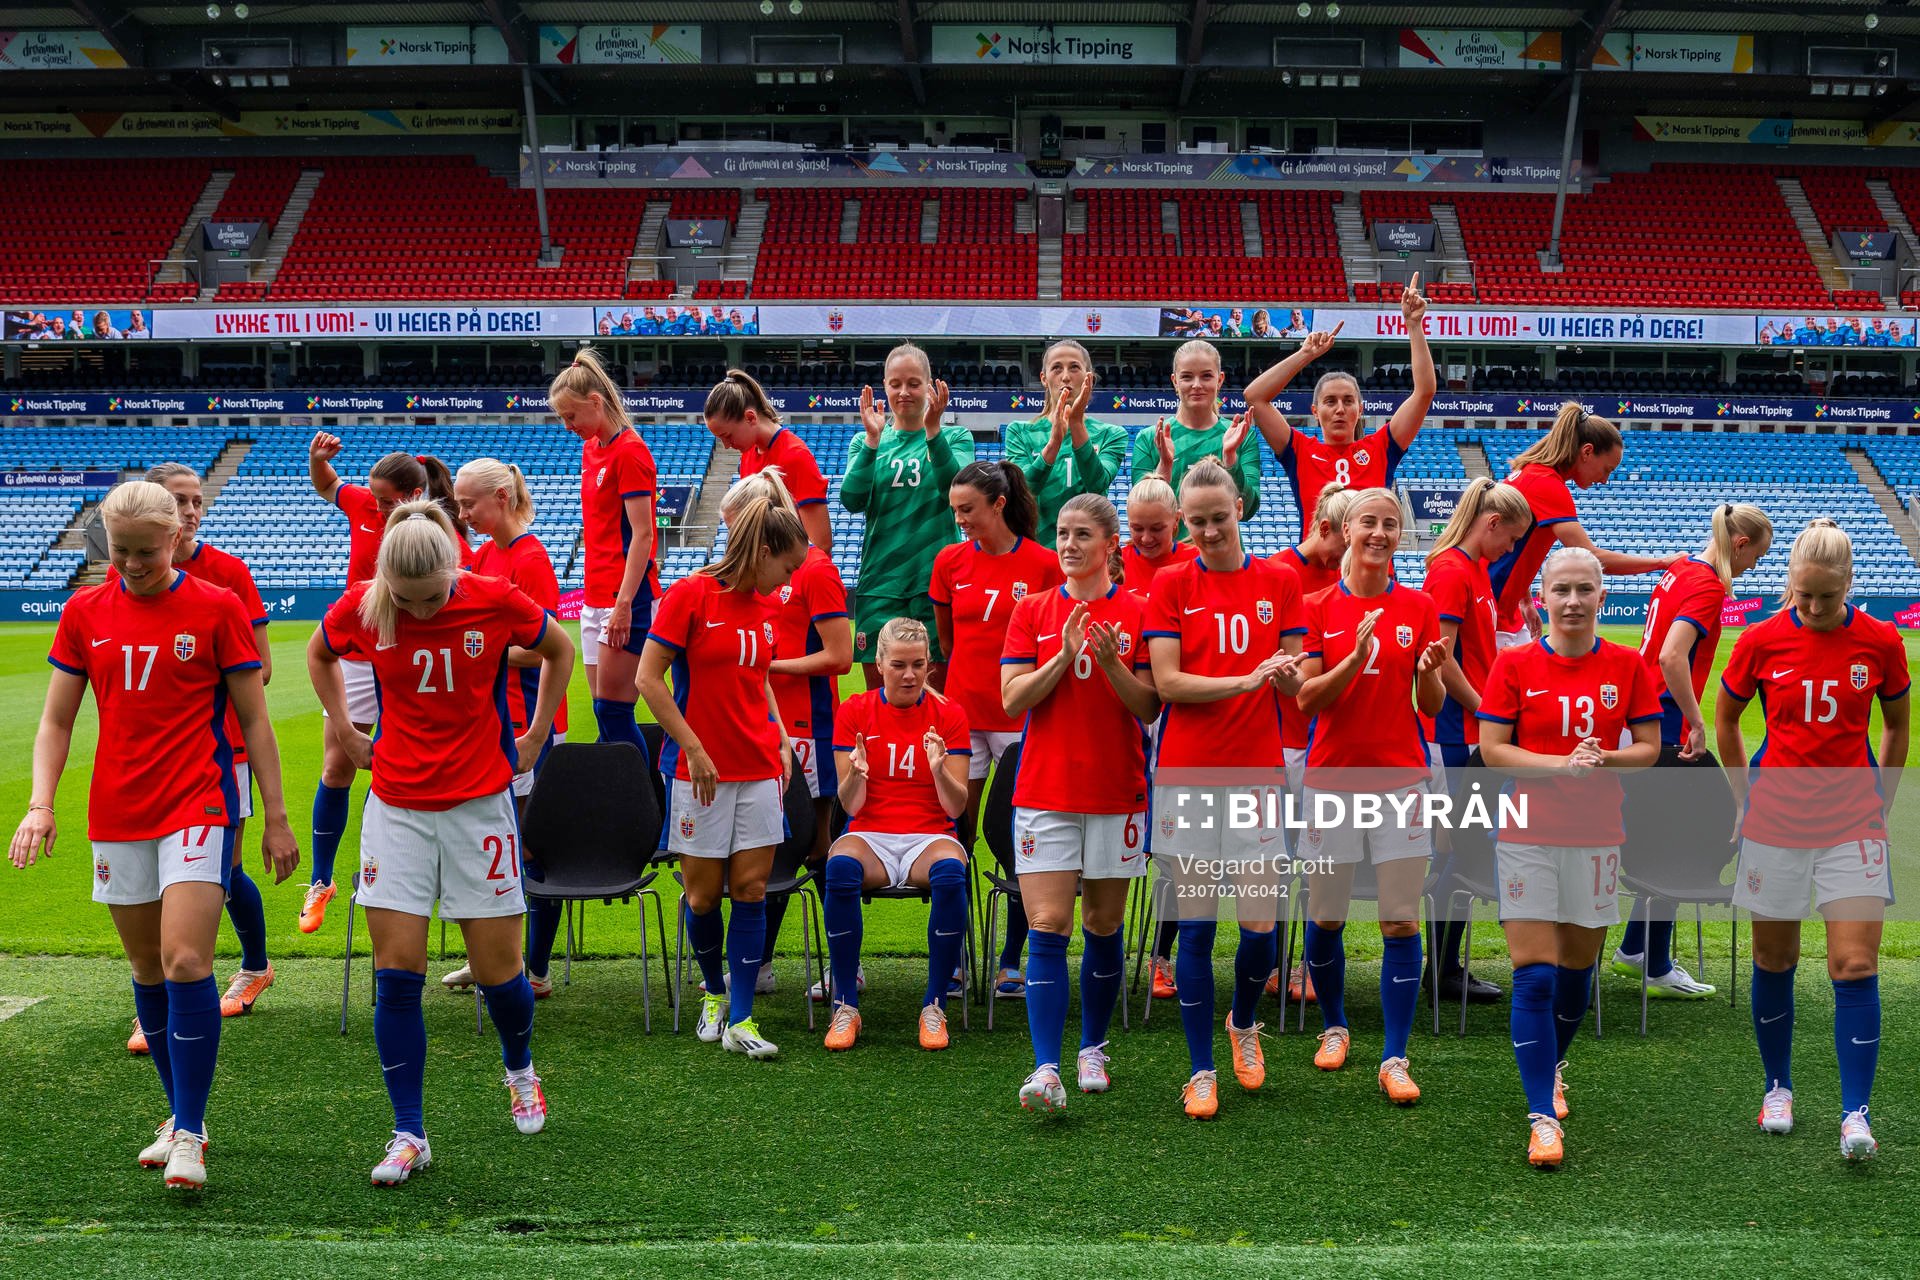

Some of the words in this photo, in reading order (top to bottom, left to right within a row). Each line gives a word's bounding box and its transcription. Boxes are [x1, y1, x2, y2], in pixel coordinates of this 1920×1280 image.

[611, 28, 621, 40] Gi
[1471, 32, 1480, 44] Gi
[400, 42, 432, 53] Norsk
[434, 42, 476, 56] Tipping
[595, 35, 638, 51] drømmen
[1008, 37, 1062, 54] Norsk
[1065, 38, 1133, 59] Tipping
[1645, 48, 1678, 60] Norsk
[1679, 48, 1721, 63] Tipping
[4, 122, 33, 131] Norsk
[35, 121, 71, 132] Tipping
[292, 119, 321, 129] Norsk
[323, 118, 360, 130] Tipping
[1672, 125, 1701, 135] Norsk
[1703, 125, 1740, 137] Tipping
[566, 161, 596, 171] Norsk
[598, 160, 637, 174] Tipping
[724, 158, 736, 172] Gi
[739, 158, 779, 172] drømmen
[781, 161, 795, 170] en
[796, 157, 831, 174] sjanse!
[936, 161, 968, 171] Norsk
[969, 160, 1007, 174] Tipping
[1122, 161, 1153, 172] Norsk
[1154, 161, 1193, 175] Tipping
[1280, 160, 1294, 175] Gi
[1295, 160, 1337, 175] drømmen
[1338, 163, 1351, 174] en
[1352, 160, 1387, 177] sjanse!
[1492, 165, 1522, 176] Norsk
[1523, 165, 1561, 179] Tipping
[215, 313, 270, 334] LYKKE
[274, 313, 300, 333] TIL
[306, 313, 310, 333] I
[400, 312, 451, 332] HEIER
[457, 306, 481, 332] PÅ
[487, 311, 541, 332] DERE!
[1437, 316, 1462, 336] TIL
[1468, 316, 1473, 336] I
[1561, 317, 1613, 338] HEIER
[1620, 313, 1644, 338] PÅ
[1650, 319, 1704, 340] DERE!
[26, 400, 52, 410] Norsk
[52, 400, 87, 412] Tipping
[124, 399, 151, 409] Norsk
[151, 400, 185, 411] Tipping
[223, 398, 250, 408] Norsk
[249, 399, 284, 410] Tipping
[322, 398, 349, 407] Norsk
[349, 398, 384, 409] Tipping
[422, 398, 449, 407] Norsk
[449, 398, 483, 409] Tipping
[521, 397, 549, 407] Norsk
[622, 397, 649, 407] Norsk
[649, 397, 684, 408] Tipping
[824, 397, 851, 407] Norsk
[953, 397, 988, 408] Tipping
[1129, 398, 1156, 407] Norsk
[1156, 398, 1181, 409] Tippi
[1230, 399, 1247, 408] Nor
[1432, 400, 1459, 410] Norsk
[1459, 400, 1494, 412] Tipping
[1533, 402, 1560, 411] Norsk
[1633, 403, 1660, 413] Norsk
[1660, 404, 1694, 416] Tipping
[1732, 405, 1759, 415] Norsk
[1759, 406, 1793, 417] Tipping
[1830, 407, 1857, 417] Norsk
[1857, 407, 1891, 419] Tipping
[890, 458, 921, 488] 23
[1065, 457, 1072, 488] 1
[1335, 458, 1351, 486] 8
[5, 473, 15, 485] Gi
[48, 476, 57, 484] en
[58, 473, 84, 486] sjanse!
[982, 589, 1000, 622] 7
[1723, 601, 1759, 613] NDAGENS
[1214, 613, 1250, 655] 10
[737, 628, 757, 667] 11
[1074, 639, 1092, 680] 6
[1362, 636, 1381, 675] 2
[121, 645, 160, 691] 17
[412, 648, 455, 693] 21
[1801, 680, 1839, 723] 15
[1557, 695, 1595, 739] 13
[887, 743, 916, 778] 14
[1123, 813, 1138, 849] 6
[483, 834, 518, 881] 21
[1591, 853, 1618, 897] 13
